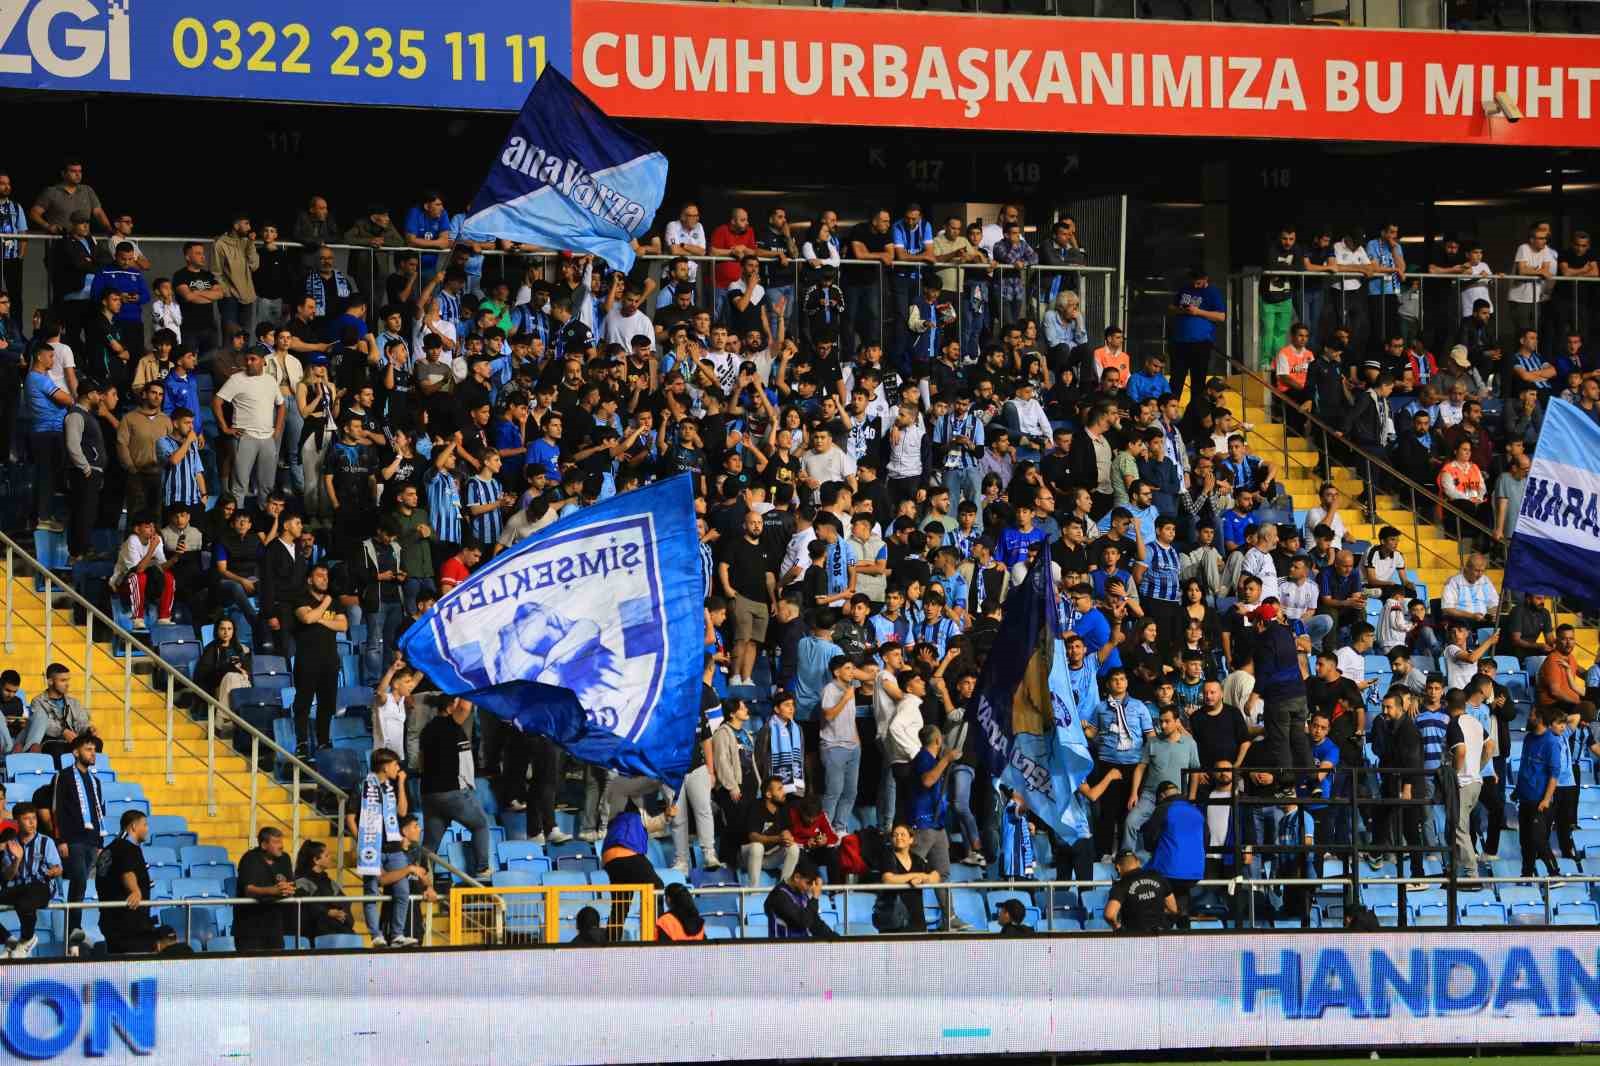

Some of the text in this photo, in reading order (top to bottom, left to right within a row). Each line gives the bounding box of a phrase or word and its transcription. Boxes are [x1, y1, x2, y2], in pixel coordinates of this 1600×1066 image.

[173, 18, 546, 82] 0322 235 11 11
[583, 32, 1600, 119] CUMHURBAŞKANIMIZA BU MUHT
[0, 976, 158, 1061] ON
[1240, 946, 1600, 1019] HANDAN
